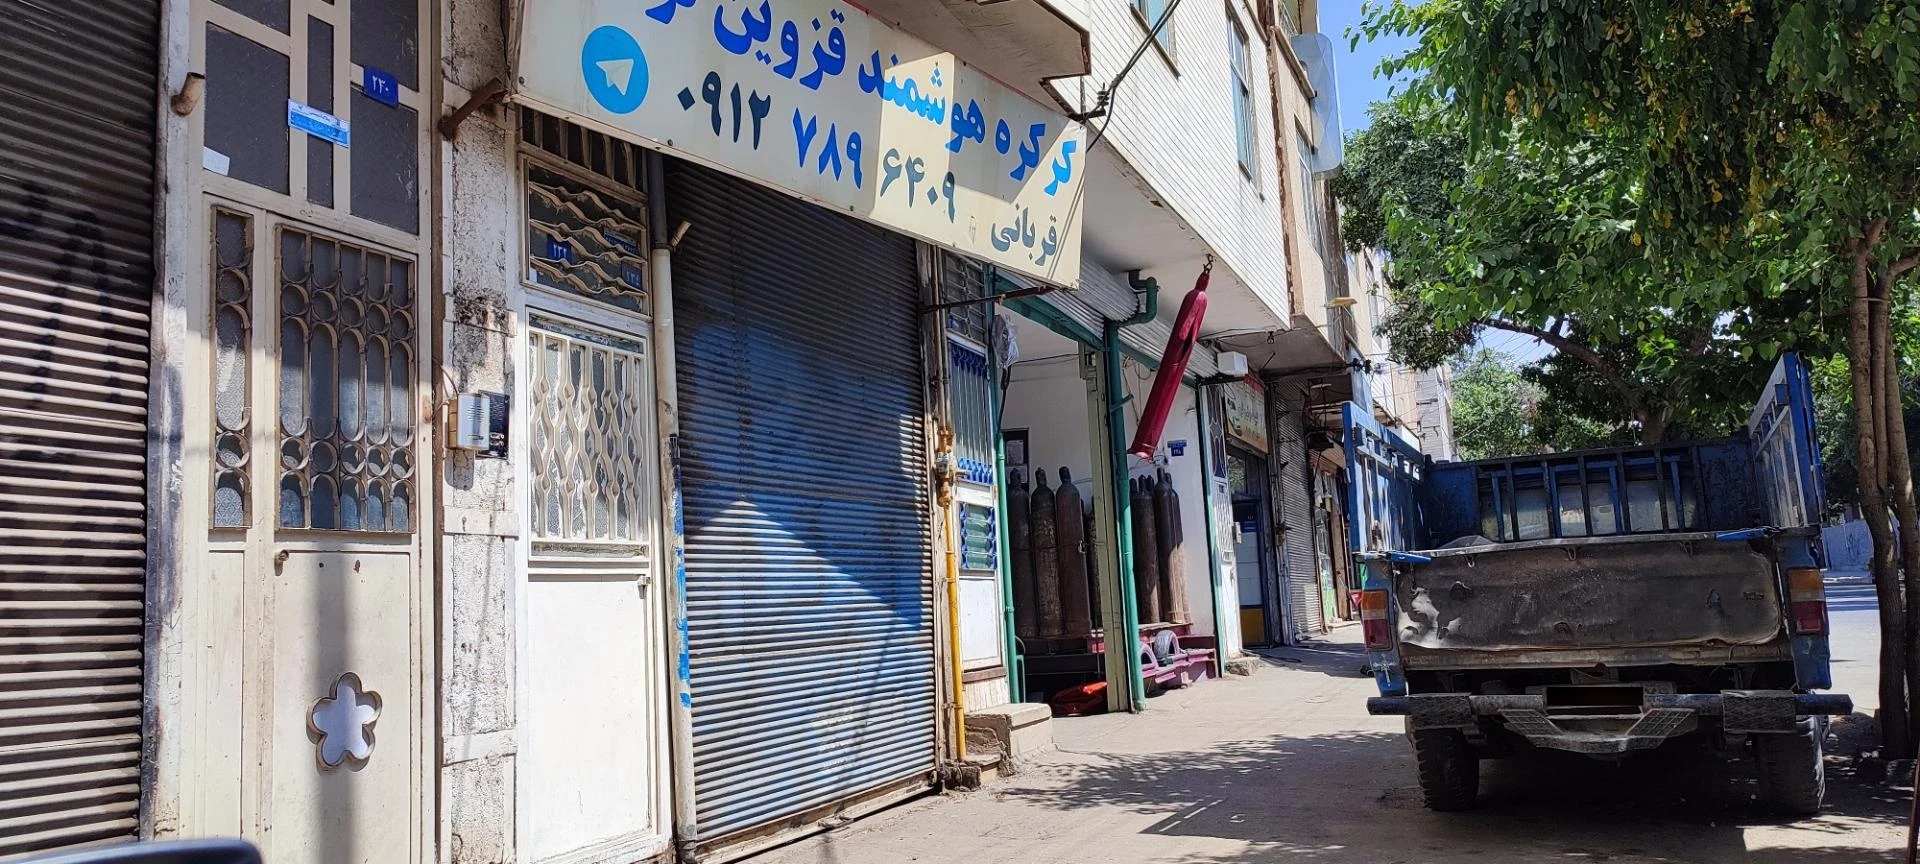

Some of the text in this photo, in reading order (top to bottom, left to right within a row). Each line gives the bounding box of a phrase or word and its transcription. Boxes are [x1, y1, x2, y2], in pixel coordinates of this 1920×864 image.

[371, 75, 389, 94] ۲۳۰
[859, 50, 985, 153] هوشمند
[677, 71, 956, 224] ۰۹۱۲ ۷۸۹ ۶۴۰۹
[991, 203, 1057, 267] قربانی
